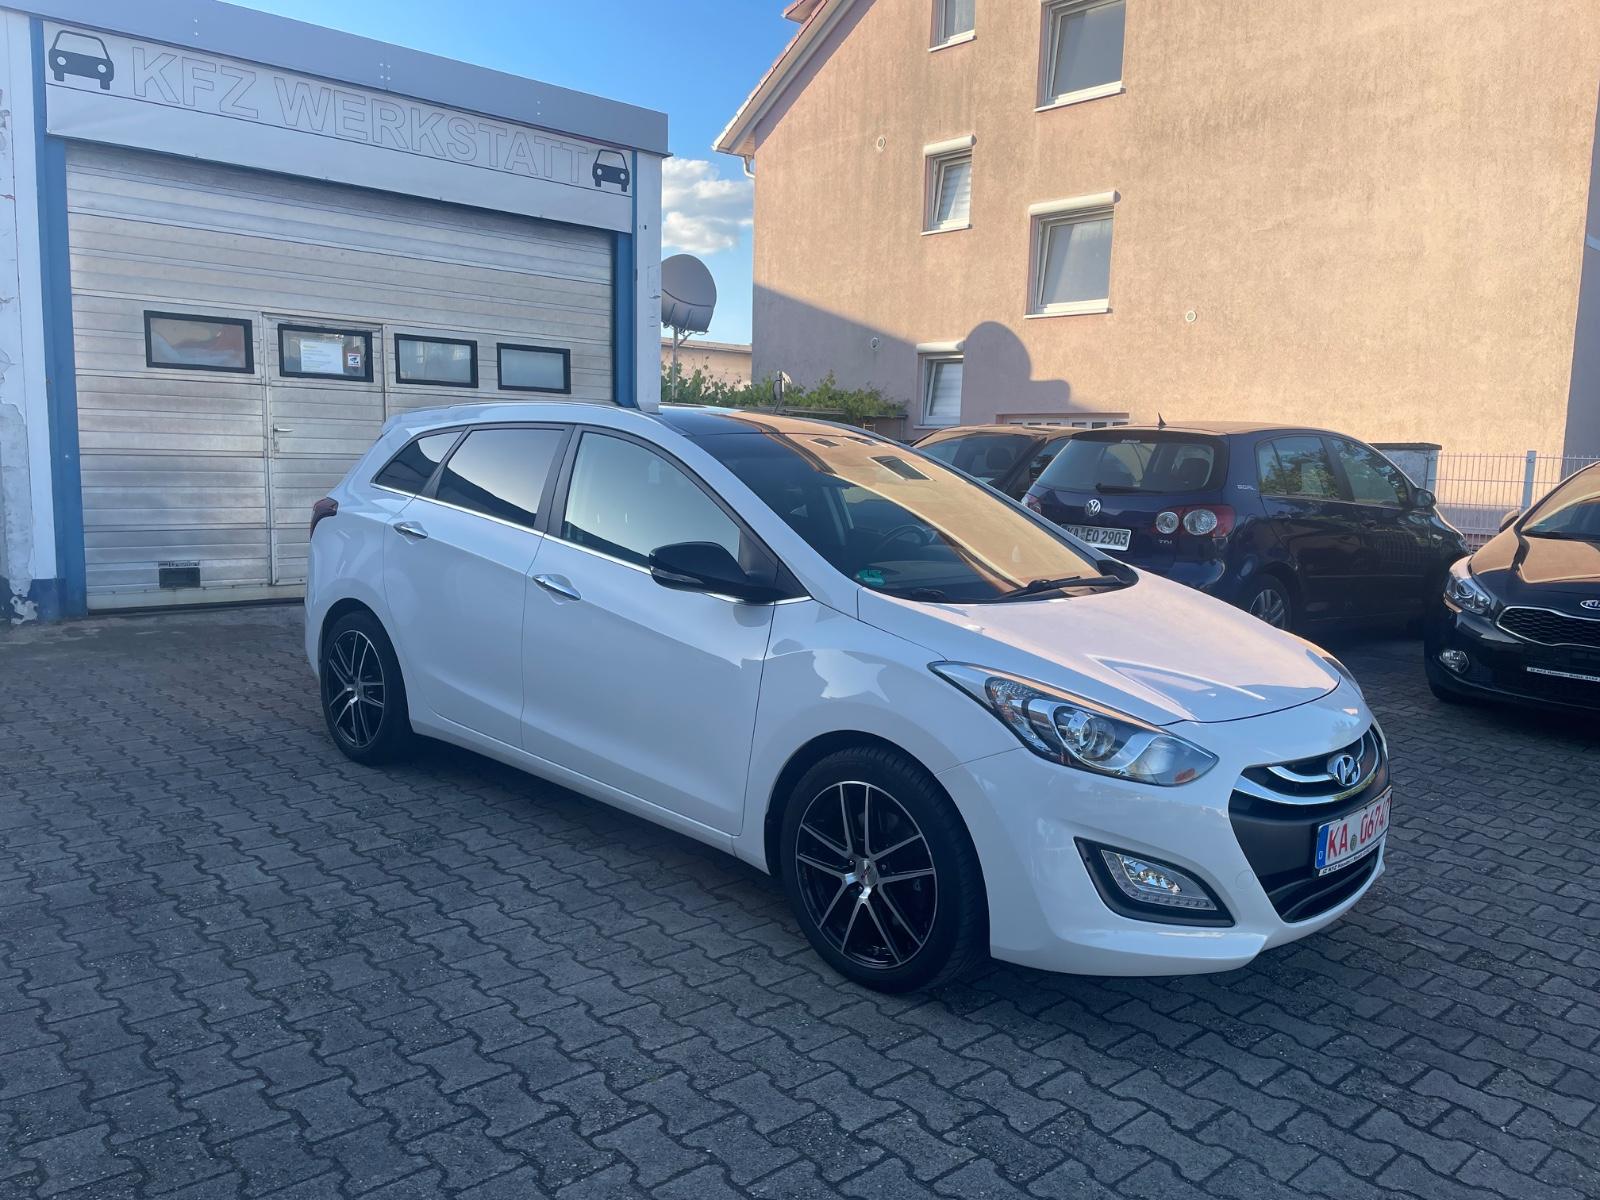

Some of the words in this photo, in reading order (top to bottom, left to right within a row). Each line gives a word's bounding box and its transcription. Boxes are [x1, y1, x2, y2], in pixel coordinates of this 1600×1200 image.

[132, 46, 259, 120] KFZ
[273, 76, 588, 184] WERKSTATT
[1102, 531, 1129, 546] 2903
[1328, 823, 1348, 860] KA
